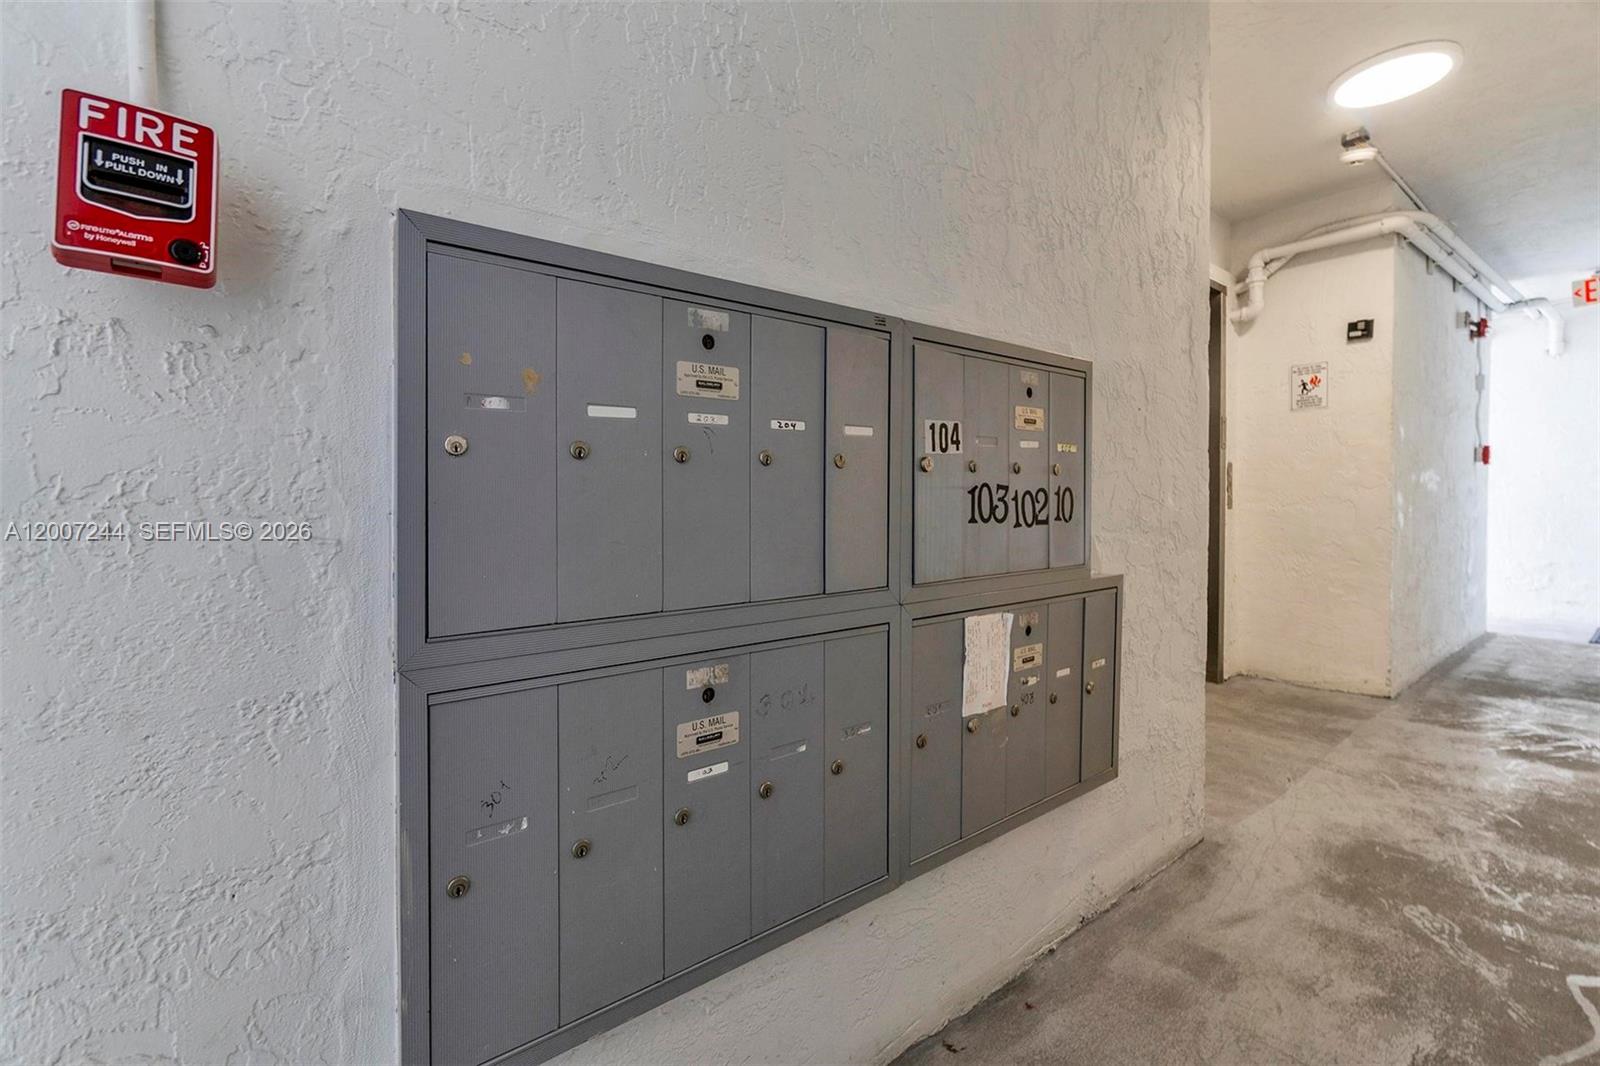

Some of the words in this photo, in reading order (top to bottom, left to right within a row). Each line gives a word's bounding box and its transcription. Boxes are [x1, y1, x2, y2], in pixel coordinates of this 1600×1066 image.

[78, 97, 199, 157] FIRE
[104, 160, 136, 176] PULL
[137, 168, 175, 184] DOWN
[111, 152, 146, 168] PUSH
[155, 162, 168, 173] IN
[83, 231, 95, 241] by
[95, 233, 136, 247] Honeywell
[691, 364, 707, 375] U.S.
[708, 366, 727, 376] MAIL
[776, 420, 797, 430] 204
[929, 422, 961, 453] 104
[967, 482, 1009, 524] 103
[1011, 487, 1049, 528] 102
[1054, 485, 1074, 523] 10
[691, 720, 707, 732] U.S.
[708, 715, 727, 728] MAIL
